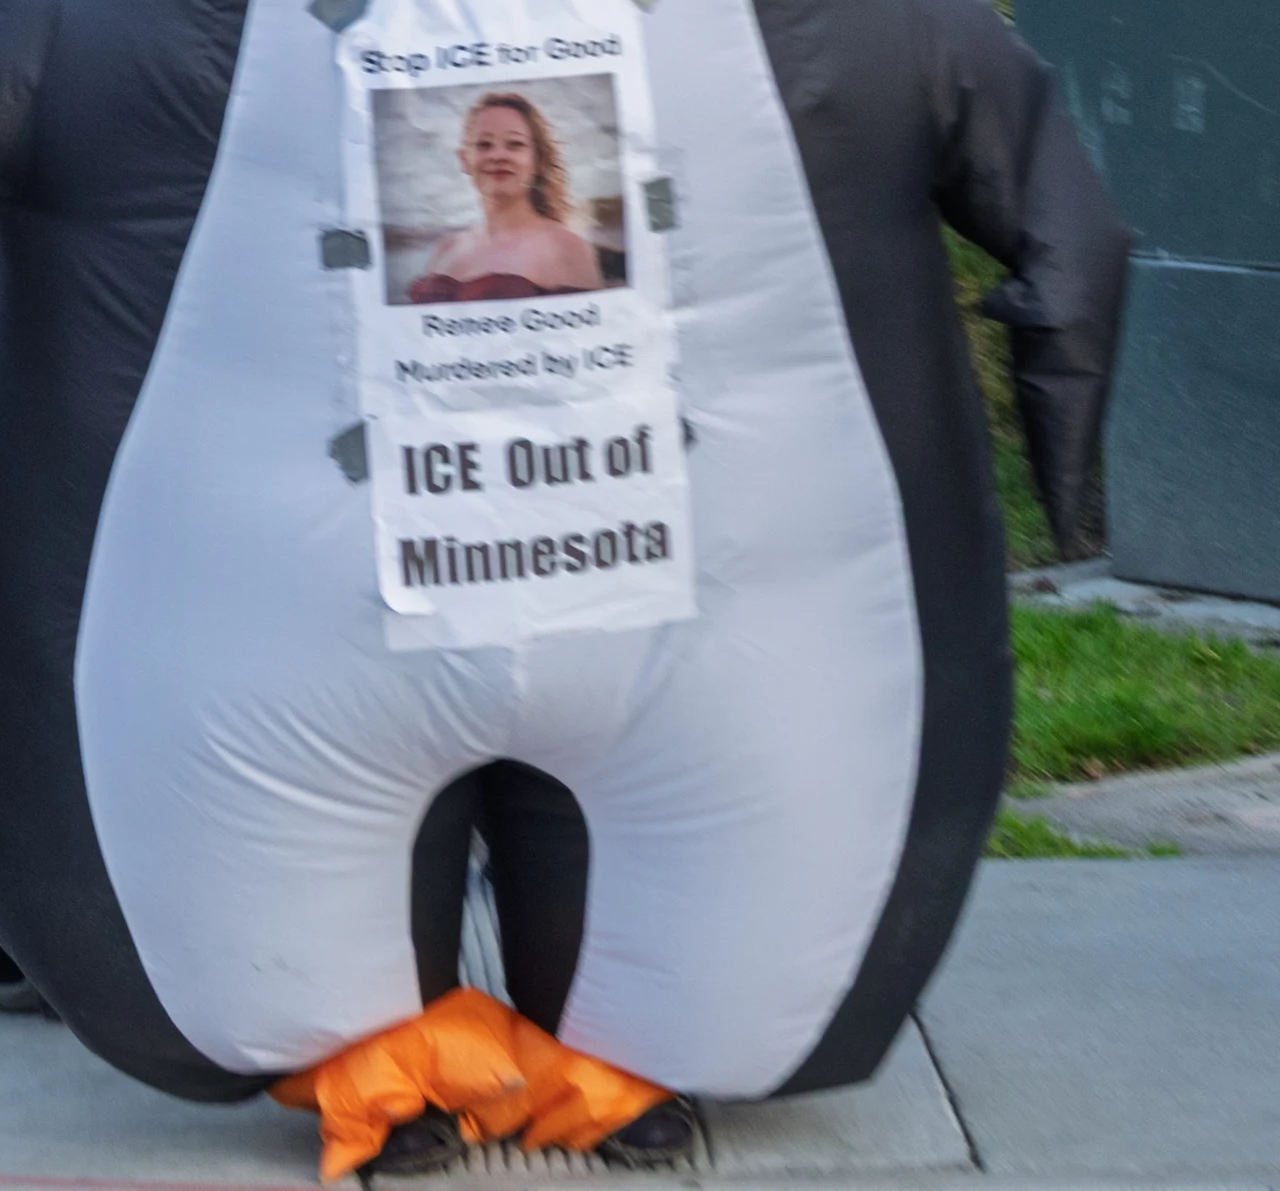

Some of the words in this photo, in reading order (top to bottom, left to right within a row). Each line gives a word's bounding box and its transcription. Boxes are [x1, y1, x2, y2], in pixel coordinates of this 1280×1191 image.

[360, 48, 430, 77] Stop
[435, 40, 493, 69] ICE
[494, 42, 540, 63] for
[542, 34, 622, 60] Good
[421, 313, 517, 337] Renee
[520, 302, 600, 332] Good
[395, 352, 538, 382] Murdered
[540, 350, 577, 378] by
[582, 343, 635, 369] ICE
[400, 440, 484, 496] ICE
[504, 436, 594, 490] Out
[605, 423, 654, 478] of
[398, 520, 671, 588] Minnesota
